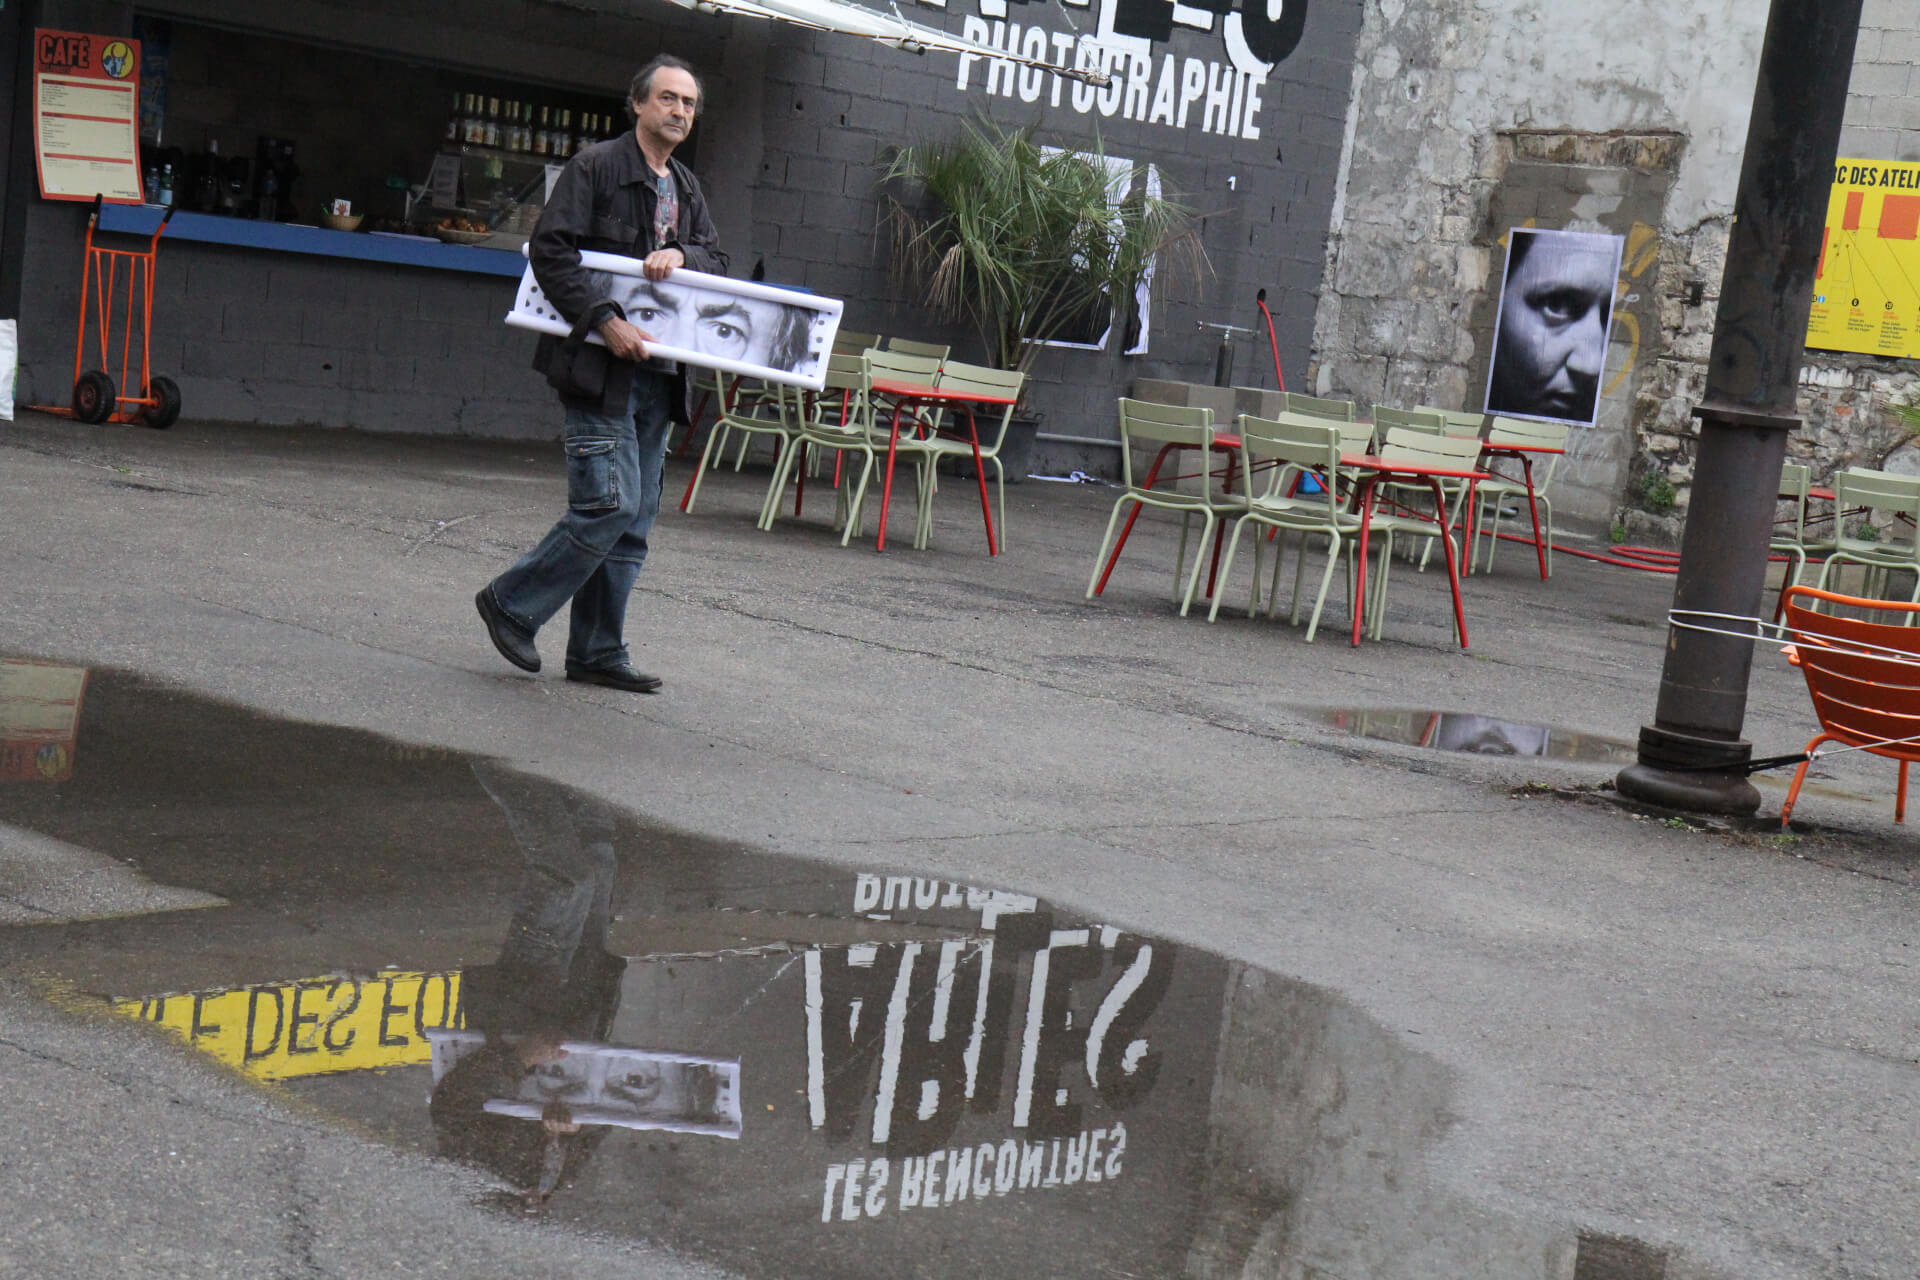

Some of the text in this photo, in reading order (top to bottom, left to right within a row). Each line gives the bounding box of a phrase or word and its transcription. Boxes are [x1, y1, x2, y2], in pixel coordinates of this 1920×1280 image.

[39, 35, 89, 69] CAFÉ
[956, 14, 1267, 139] PHOTOGRAPHIE
[1832, 165, 1847, 184] C
[1849, 166, 1878, 186] DES
